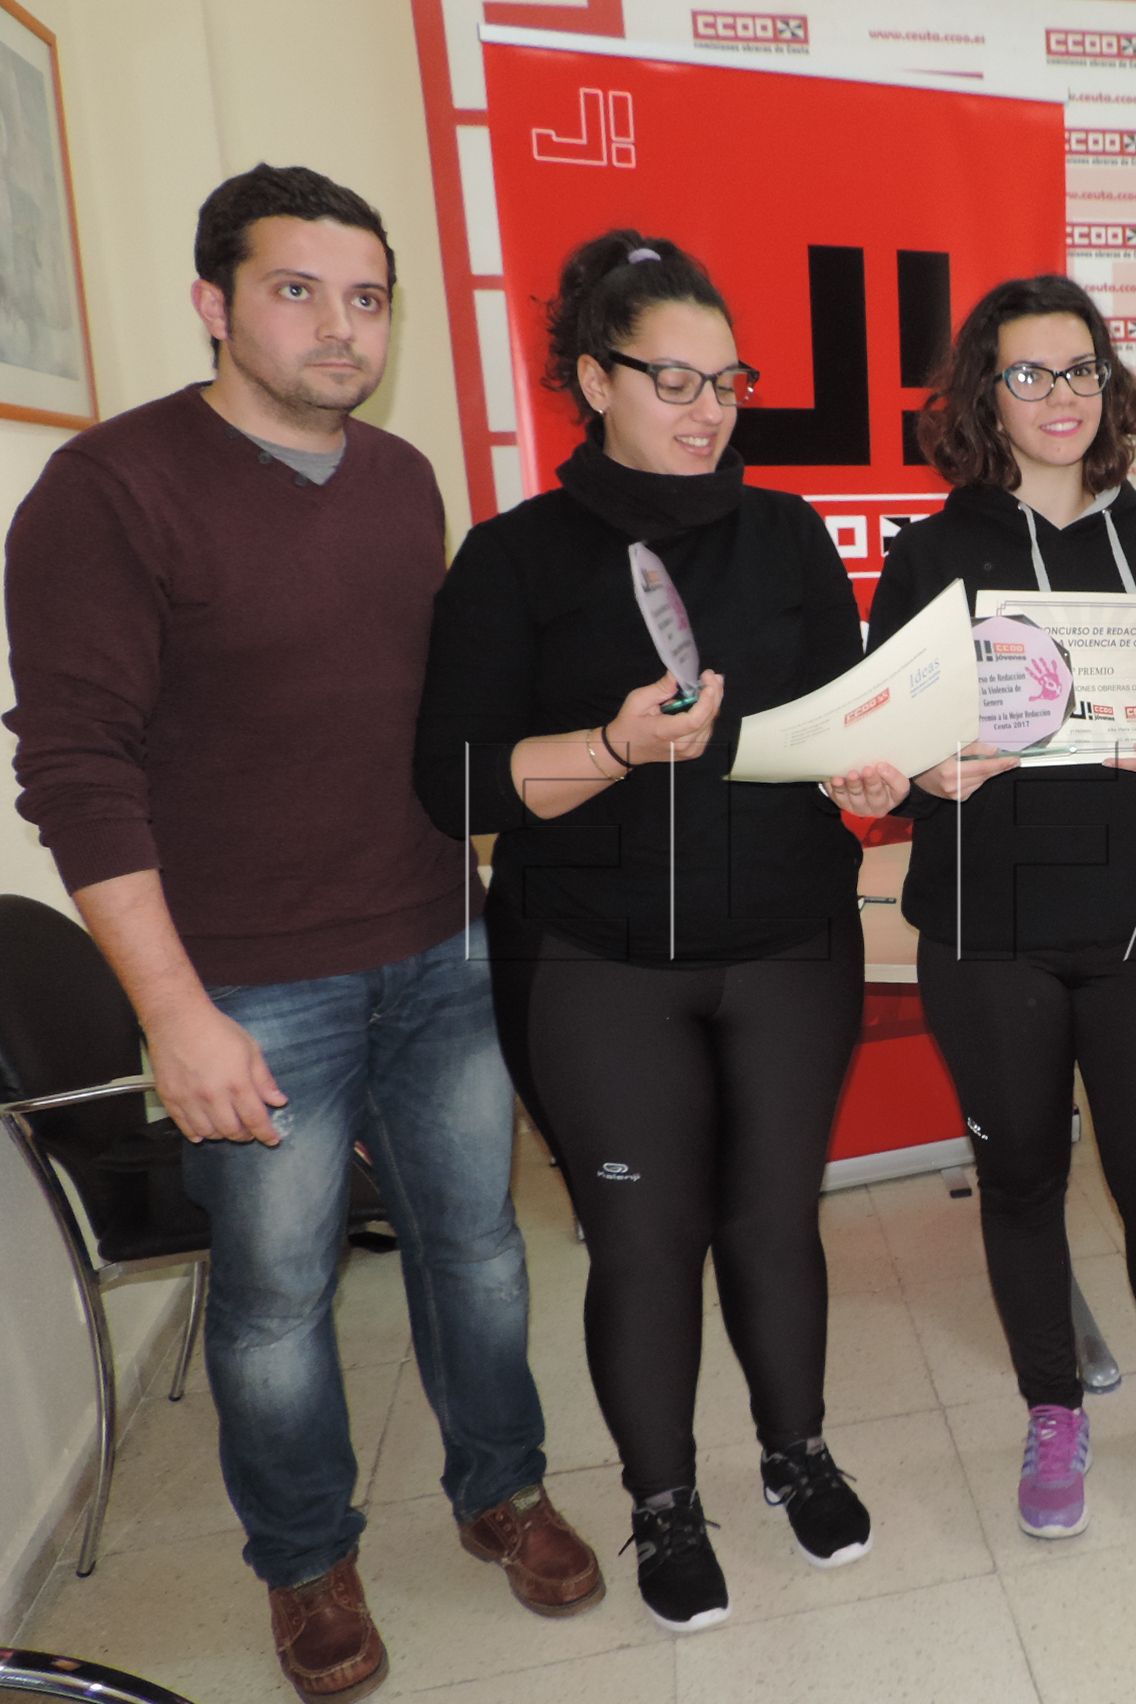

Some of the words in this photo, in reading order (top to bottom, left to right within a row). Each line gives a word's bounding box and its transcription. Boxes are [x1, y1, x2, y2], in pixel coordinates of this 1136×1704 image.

[697, 14, 774, 40] CCOO
[1050, 32, 1118, 57] CCOO
[1066, 132, 1120, 155] COO
[1044, 626, 1090, 636] ONCURSO
[1092, 626, 1104, 636] DE
[1068, 639, 1117, 648] VIOLENCIA
[1120, 639, 1131, 648] DE
[1078, 667, 1115, 676] PREMIO
[1013, 720, 1030, 728] 2017
